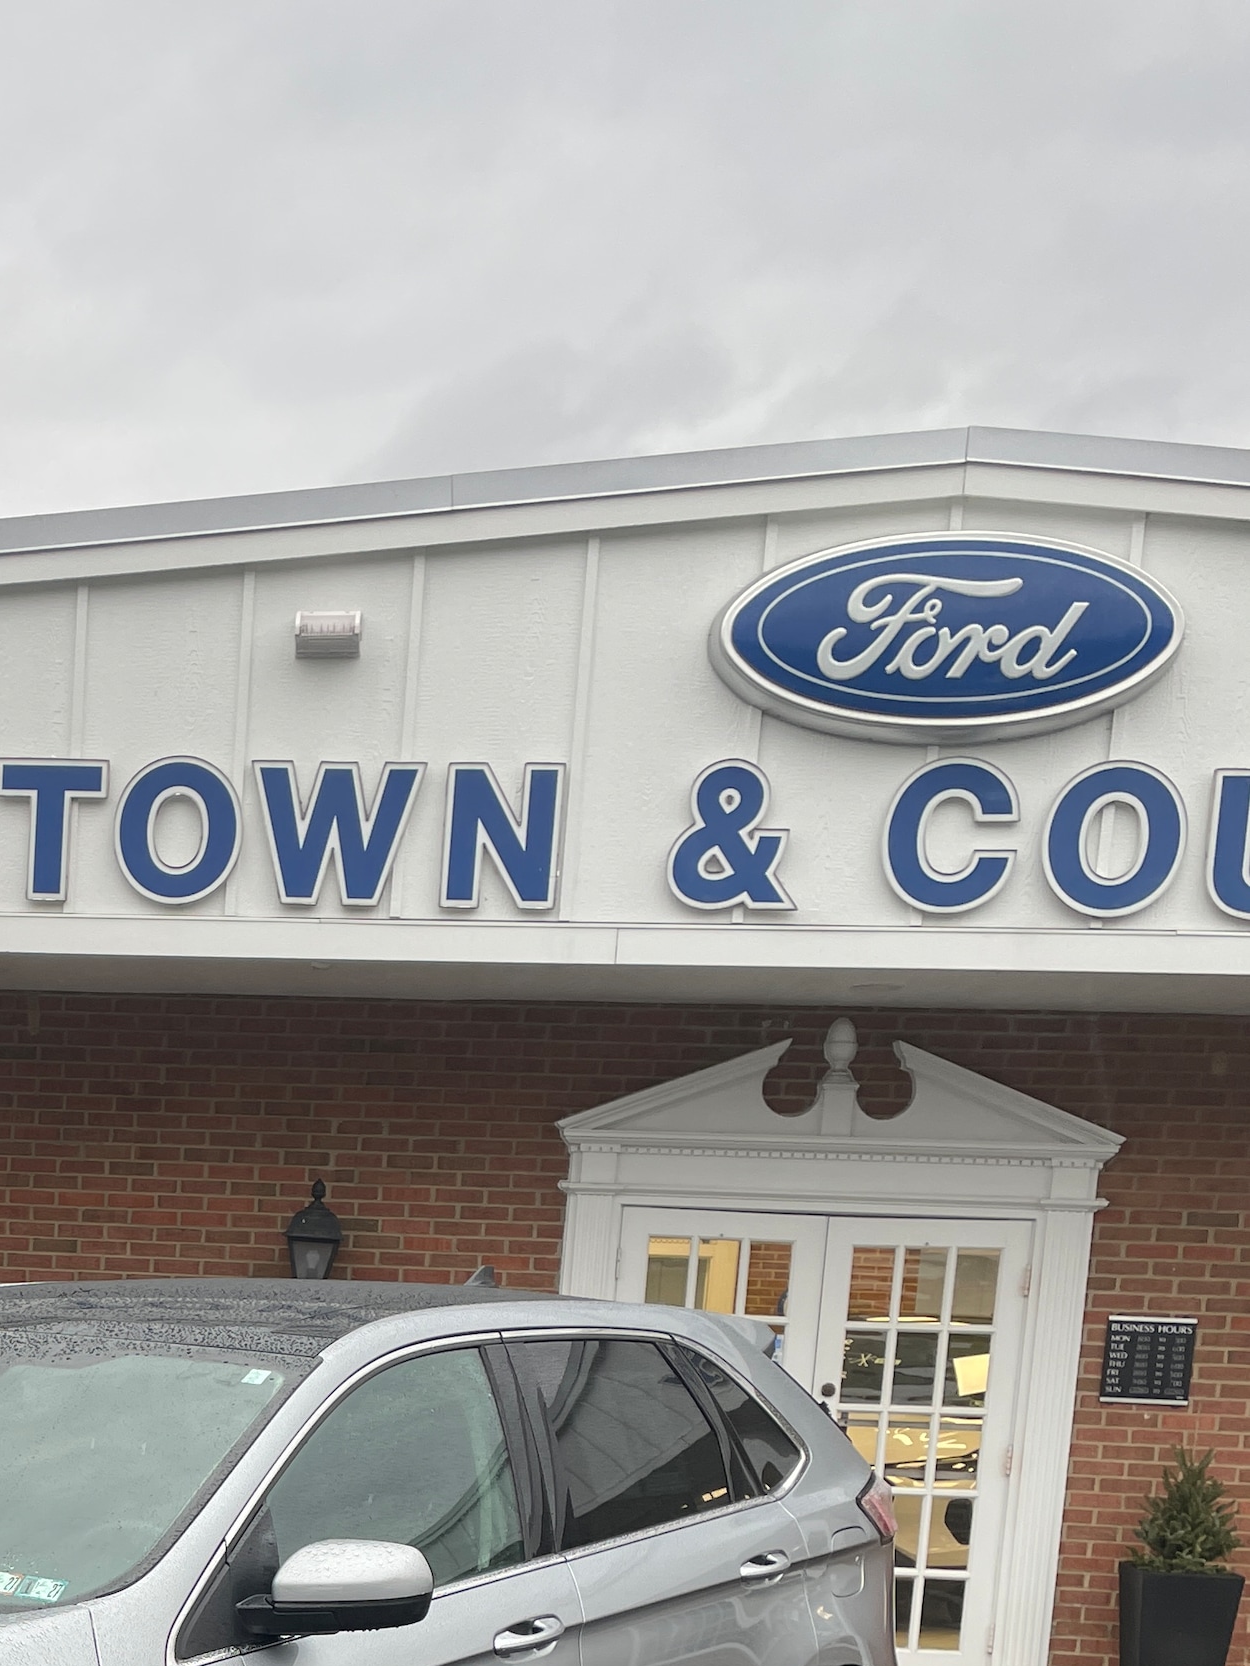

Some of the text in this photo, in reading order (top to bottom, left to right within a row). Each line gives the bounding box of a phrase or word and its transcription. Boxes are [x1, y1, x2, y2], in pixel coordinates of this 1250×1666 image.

[816, 572, 1090, 681] Ford
[668, 759, 798, 911] &
[1109, 1351, 1129, 1359] WED
[1111, 1323, 1193, 1335] BUSINESS HOURS
